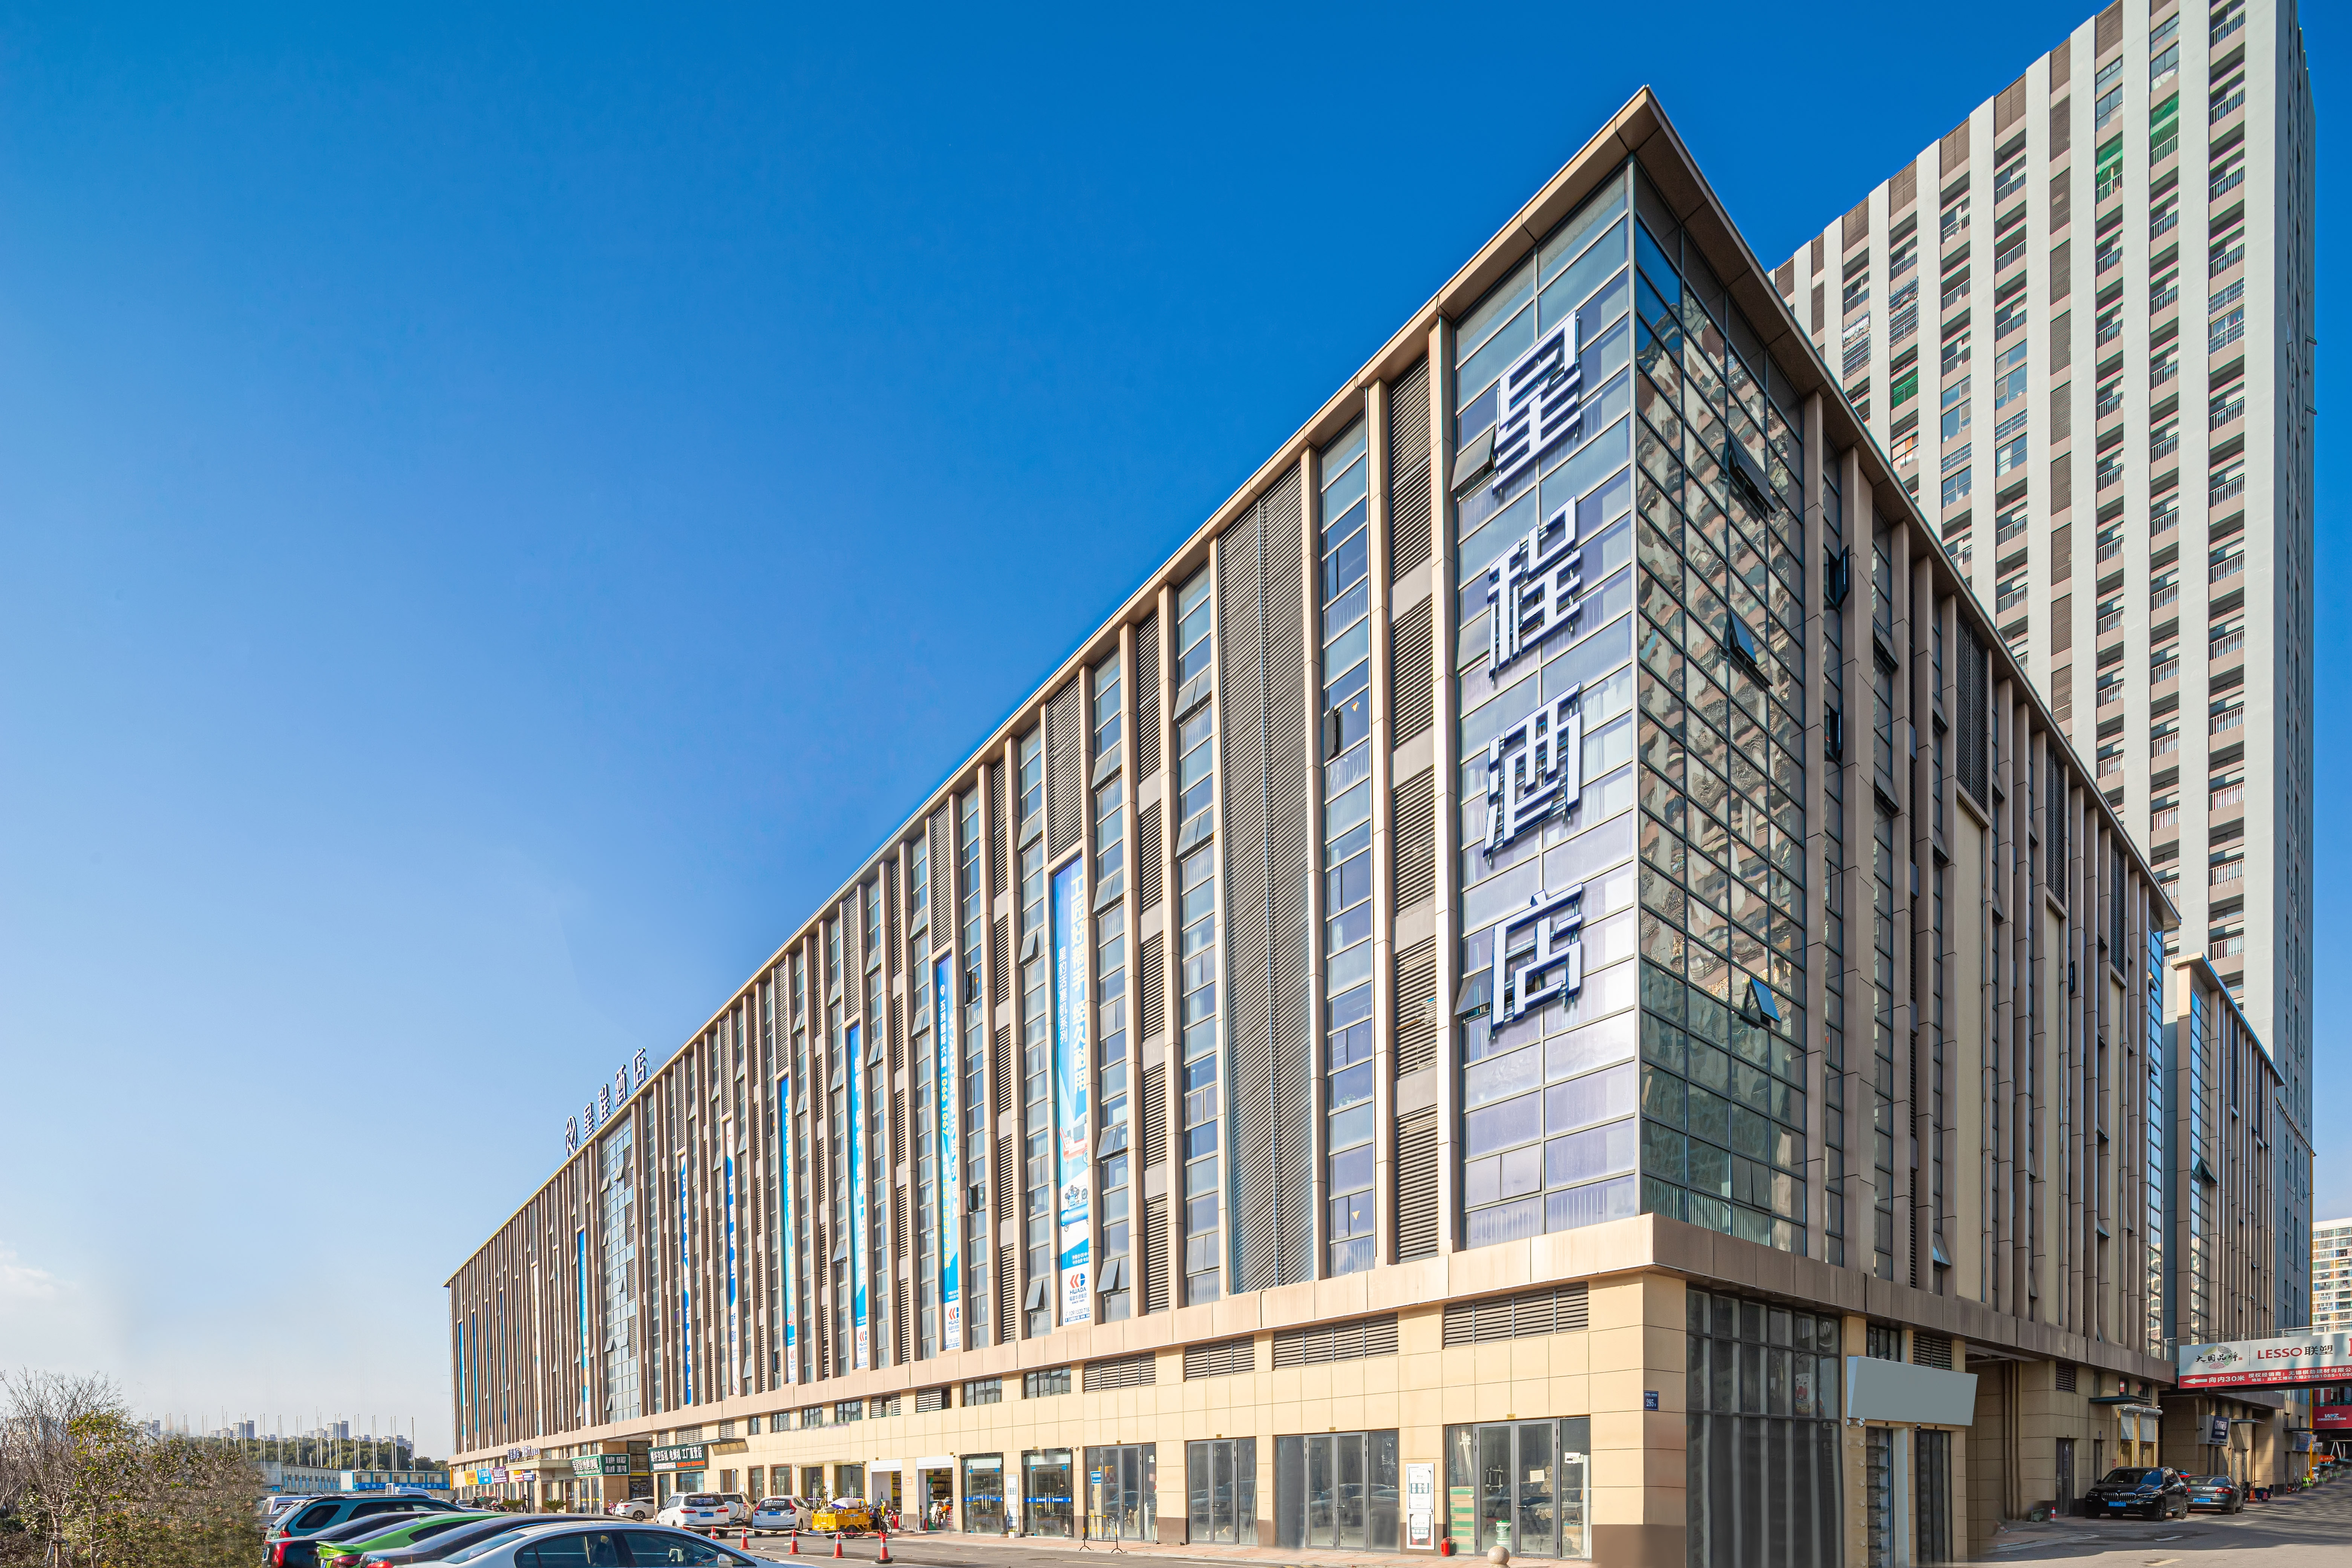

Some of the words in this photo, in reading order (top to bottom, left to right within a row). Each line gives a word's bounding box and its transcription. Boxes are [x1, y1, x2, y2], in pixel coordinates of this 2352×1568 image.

[1485, 311, 1581, 1038] 星程酒店
[1070, 874, 1085, 992] 工匠好帮手
[1058, 946, 1067, 1045] 星豹活塞机系列
[1072, 1002, 1087, 1094] 经久耐用
[584, 1047, 646, 1139] 星程酒店
[1070, 1286, 1086, 1295] HUADA
[2195, 1352, 2238, 1363] 大国品牌
[2257, 1348, 2302, 1359] LESSO
[2304, 1345, 2333, 1356] 联塑
[2209, 1375, 2245, 1383] 向内30米
[682, 1446, 703, 1459] 工厂直营店
